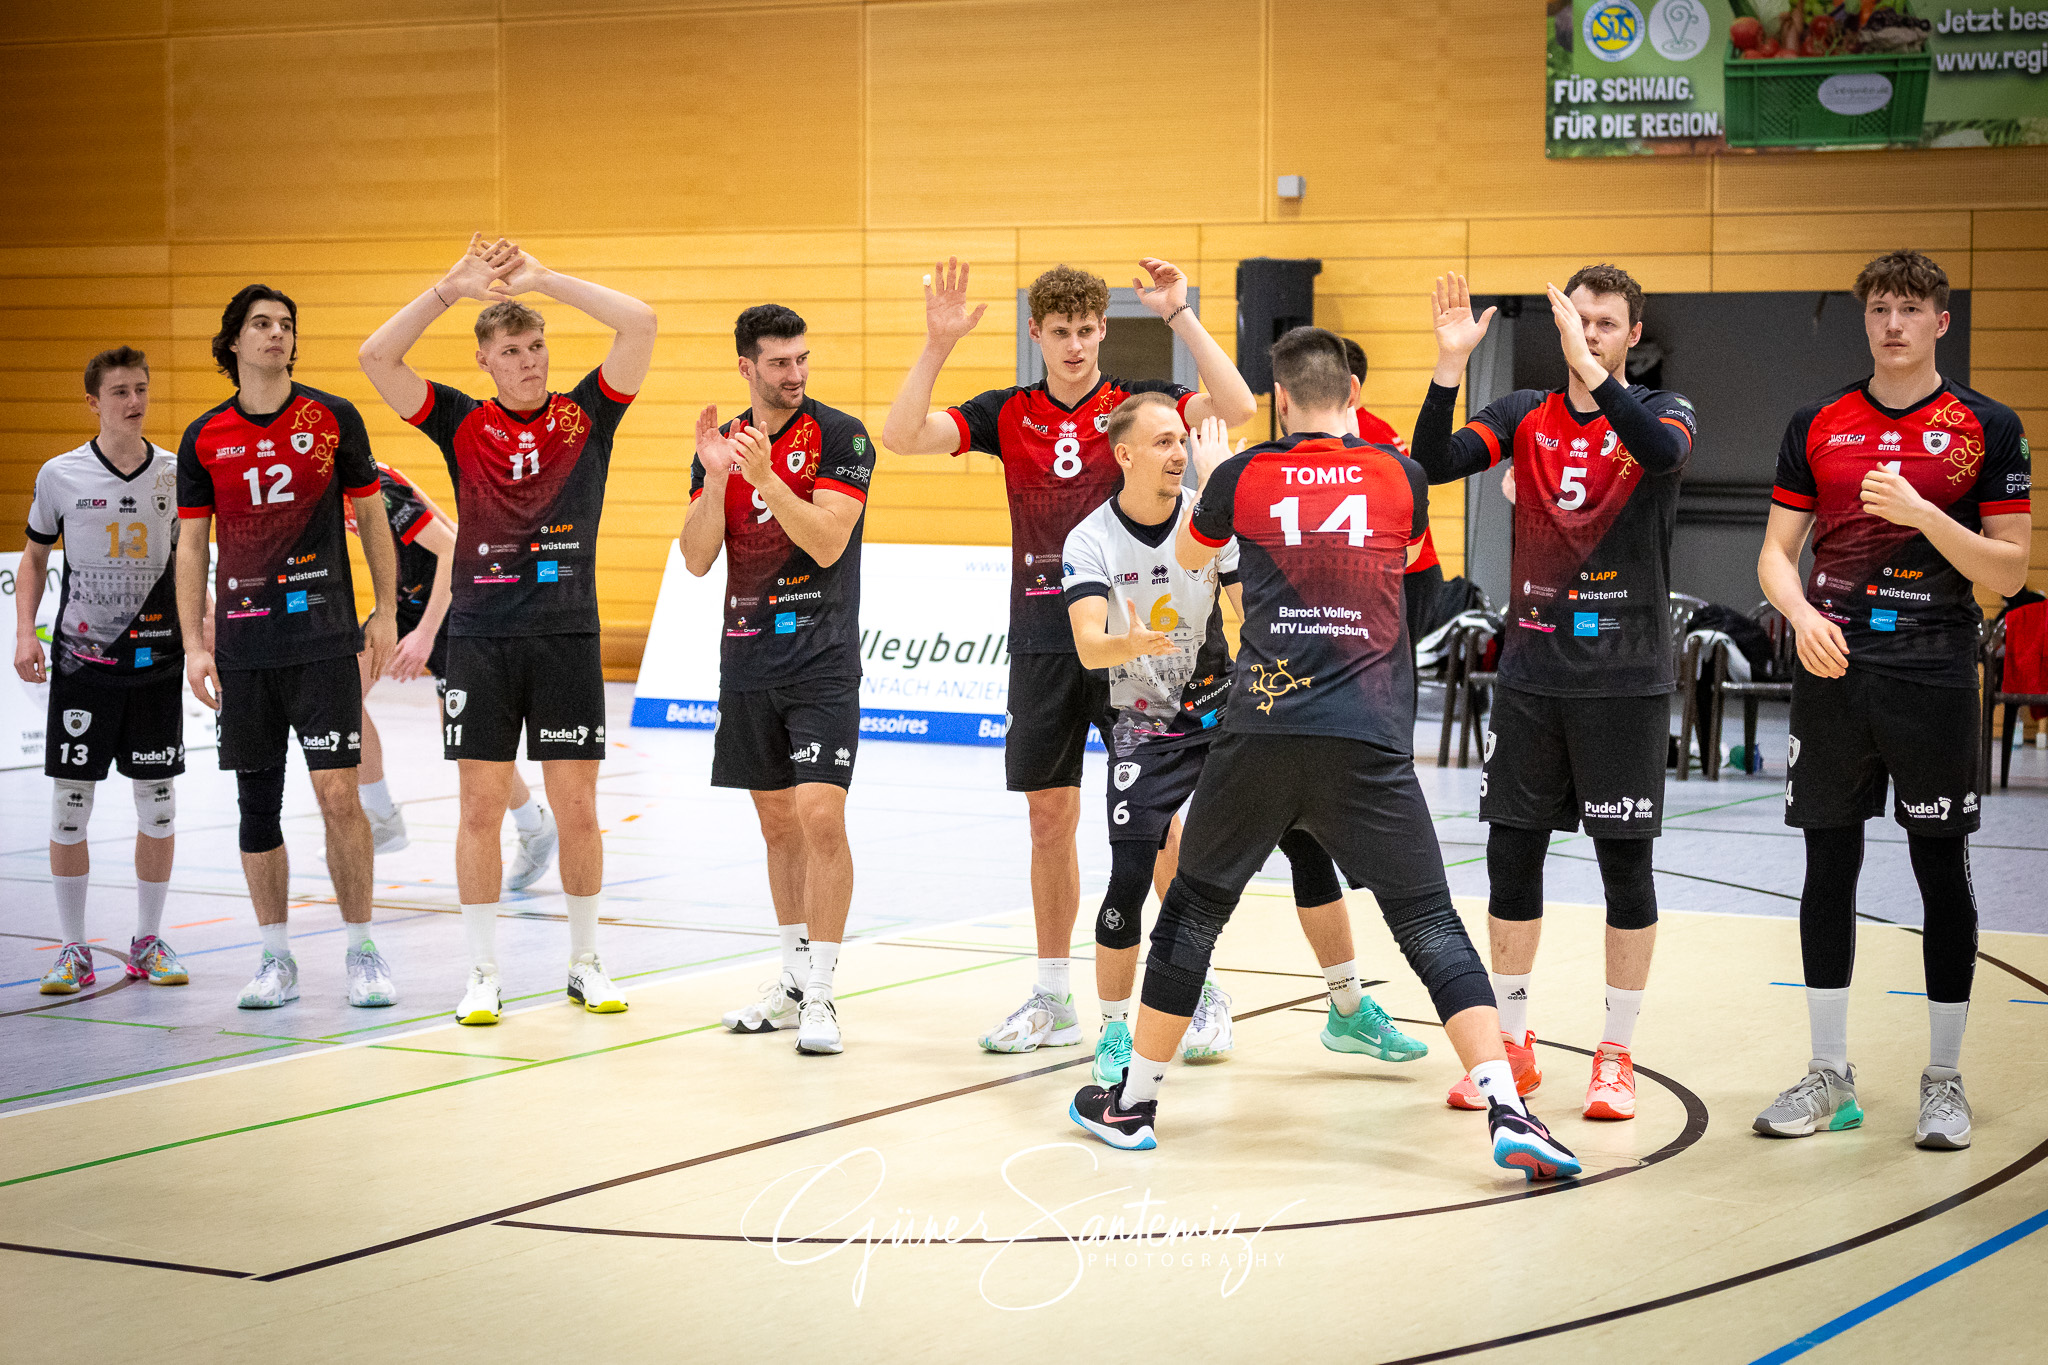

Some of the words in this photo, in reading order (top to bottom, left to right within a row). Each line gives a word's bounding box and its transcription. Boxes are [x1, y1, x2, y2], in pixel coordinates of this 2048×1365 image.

[1937, 8, 2004, 33] Jetzt
[2009, 6, 2048, 30] bes
[1936, 42, 2048, 74] www.regi
[1553, 74, 1597, 103] FÜR
[1601, 76, 1694, 102] SCHWAIG.
[1553, 110, 1597, 140] FÜR
[1601, 113, 1636, 138] DIE
[1641, 112, 1723, 137] REGION.
[509, 448, 540, 480] 11
[1053, 437, 1083, 478] 8
[243, 463, 295, 506] 12
[1281, 465, 1363, 485] TOMIC
[1557, 466, 1588, 511] 5
[751, 487, 773, 524] 9
[549, 524, 573, 533] LAPP
[1269, 494, 1374, 547] 14
[105, 522, 148, 559] 13
[540, 541, 580, 551] wüstenrot
[295, 553, 317, 564] LAPP
[287, 568, 328, 582] wüstenrot
[786, 574, 810, 586] LAPP
[1590, 571, 1618, 581] LAPP
[1893, 568, 1924, 580] LAPP
[778, 590, 821, 603] wüstenrot
[1579, 589, 1628, 600] wüstenrot
[1879, 588, 1931, 602] wüstenrot
[145, 613, 163, 622] LAPP
[1150, 593, 1179, 632] 6
[1279, 606, 1321, 618] Barock
[1323, 607, 1362, 621] Volleys
[138, 629, 172, 638] wüstenrot
[1270, 623, 1297, 634] MTV
[1298, 623, 1369, 639] Ludwigsburg
[860, 630, 1010, 669] lleyball
[864, 677, 931, 697] NFACH
[935, 680, 1008, 700] ANZIEH
[1194, 678, 1233, 707] wüstenrot
[665, 703, 718, 724] Beklei
[860, 714, 929, 735] essoires
[445, 724, 463, 746] 11
[540, 728, 577, 739] Pudel
[60, 742, 89, 766] 13
[132, 750, 166, 761] Pudel
[1119, 763, 1133, 771] MTV
[1480, 772, 1489, 798] 5
[1785, 780, 1794, 807] 4
[1112, 800, 1130, 825] 6
[1584, 801, 1622, 814] Pudel
